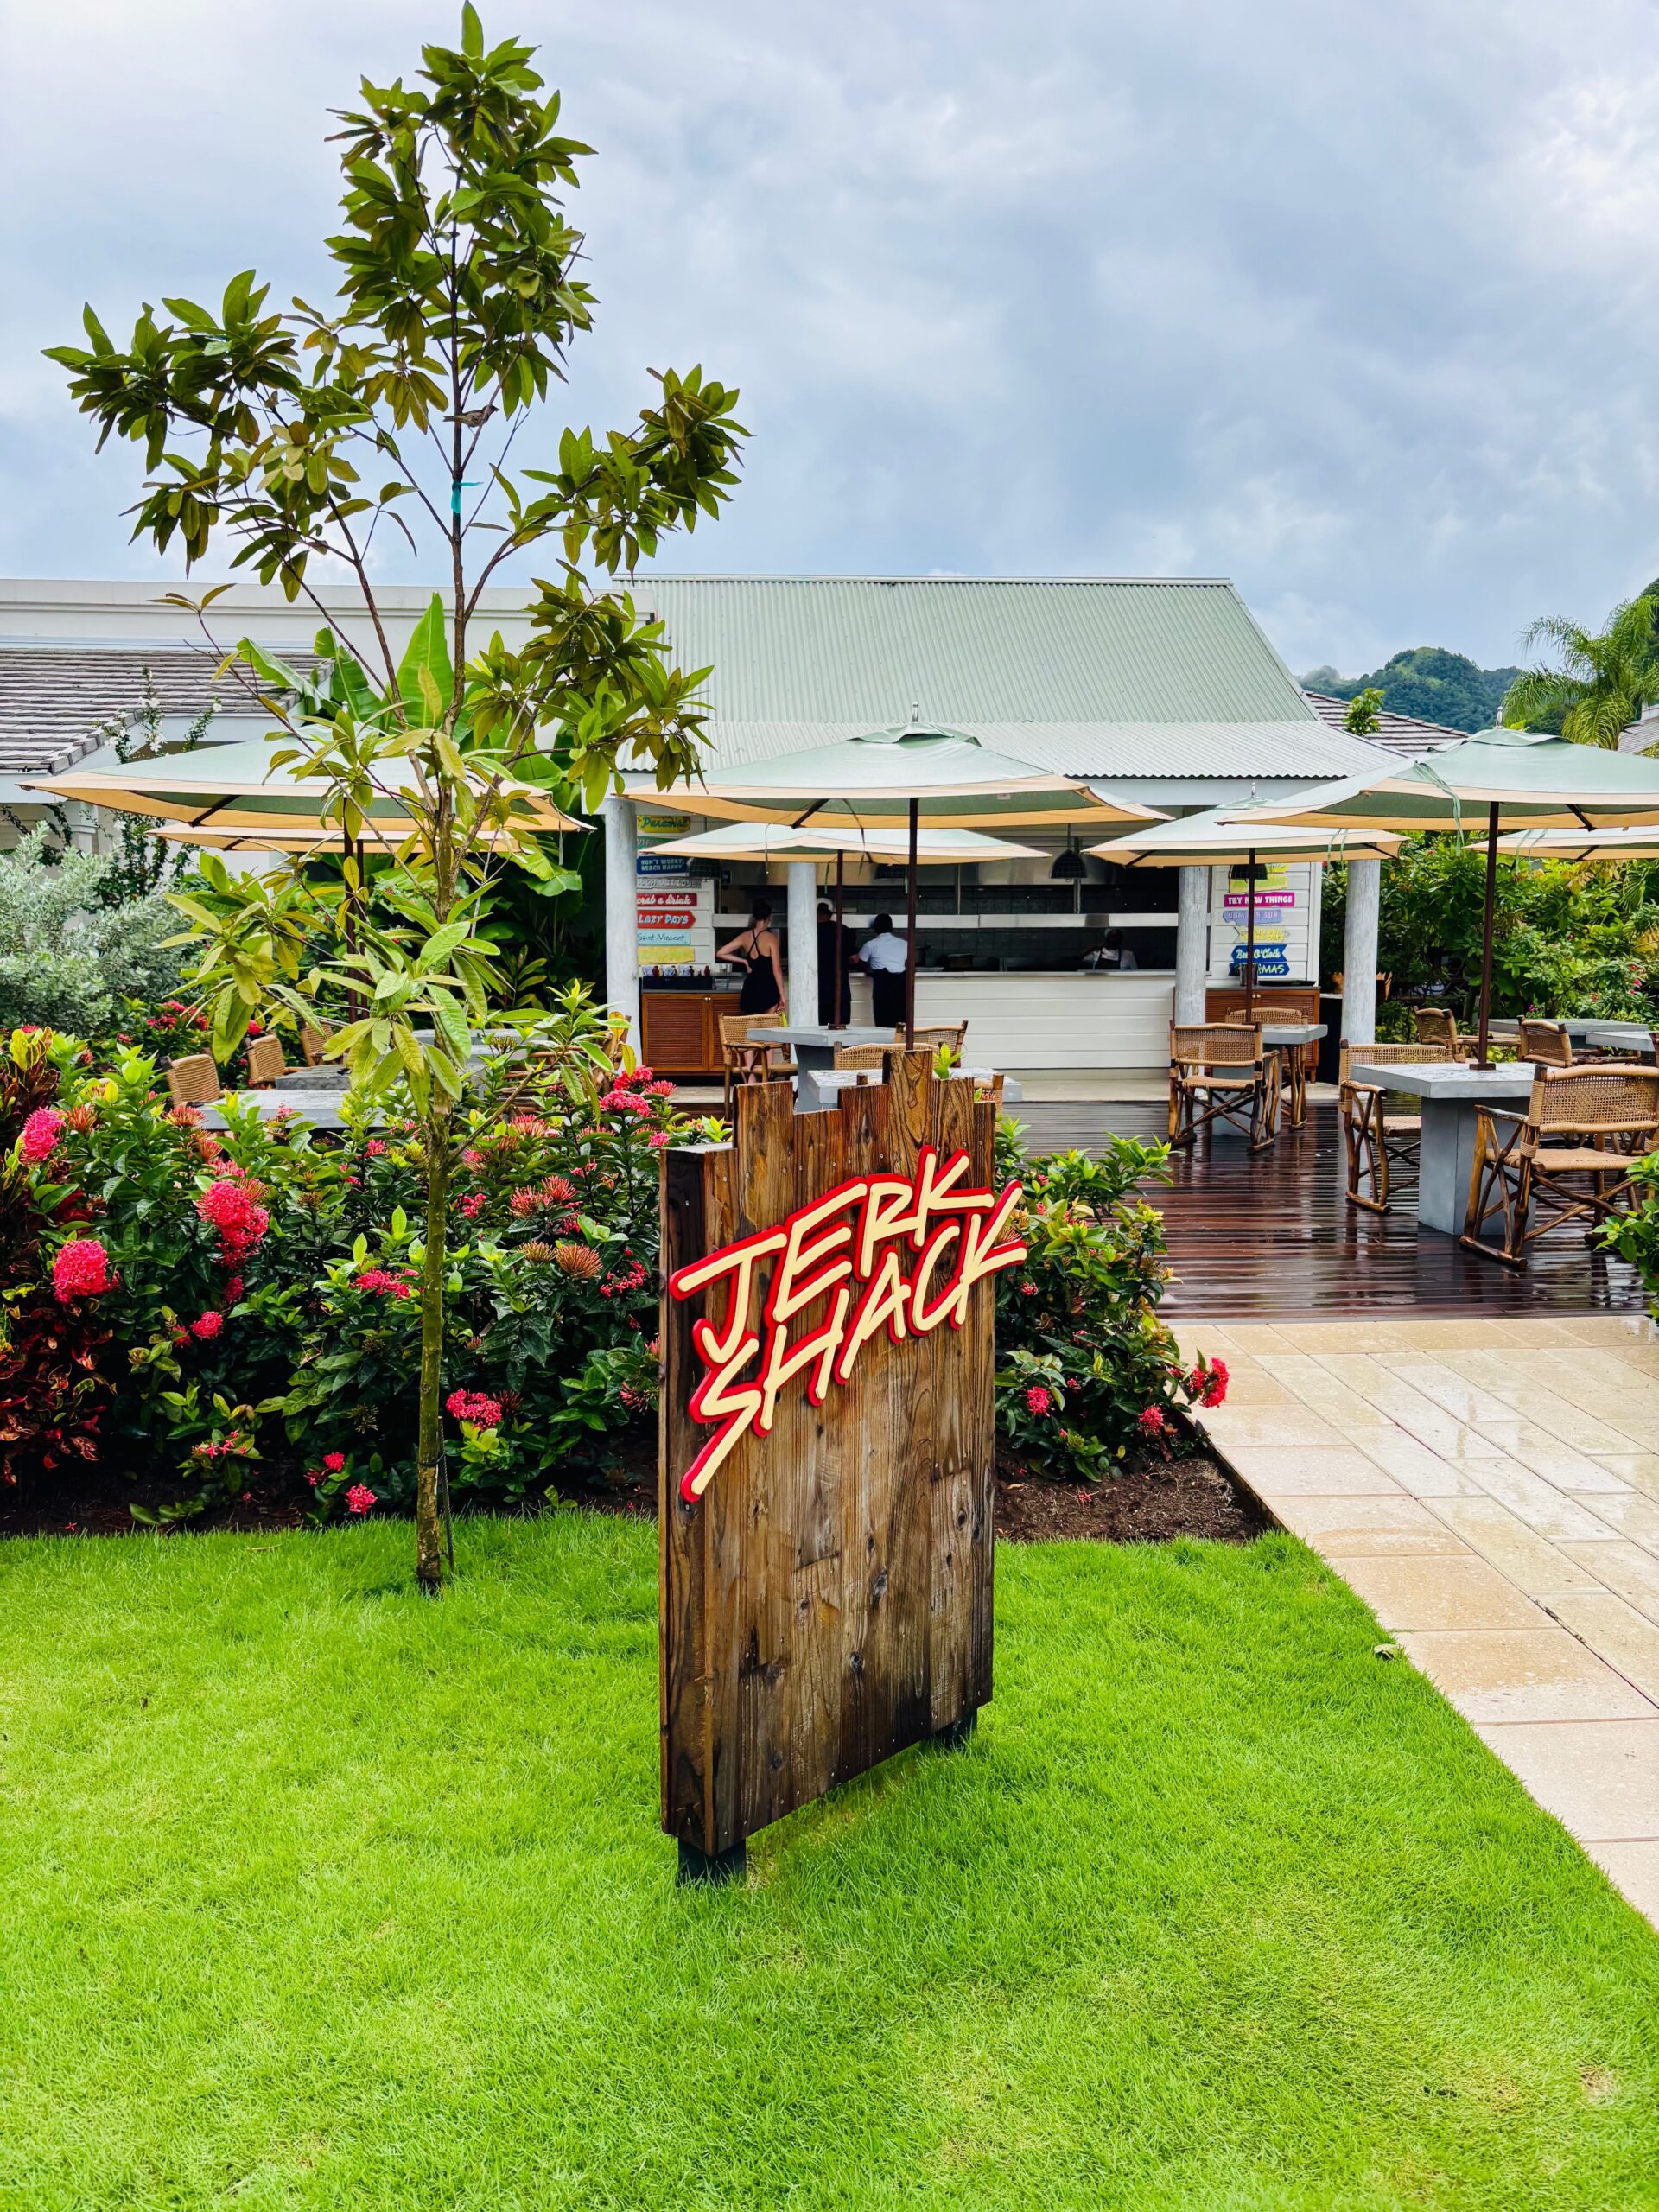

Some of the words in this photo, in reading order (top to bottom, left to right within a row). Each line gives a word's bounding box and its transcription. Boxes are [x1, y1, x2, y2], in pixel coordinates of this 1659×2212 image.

[639, 914, 663, 924] LAZY
[664, 914, 690, 925] DAYS
[665, 894, 691, 905] drink
[669, 1145, 995, 1365] JERK
[682, 1179, 1027, 1503] SHACK
